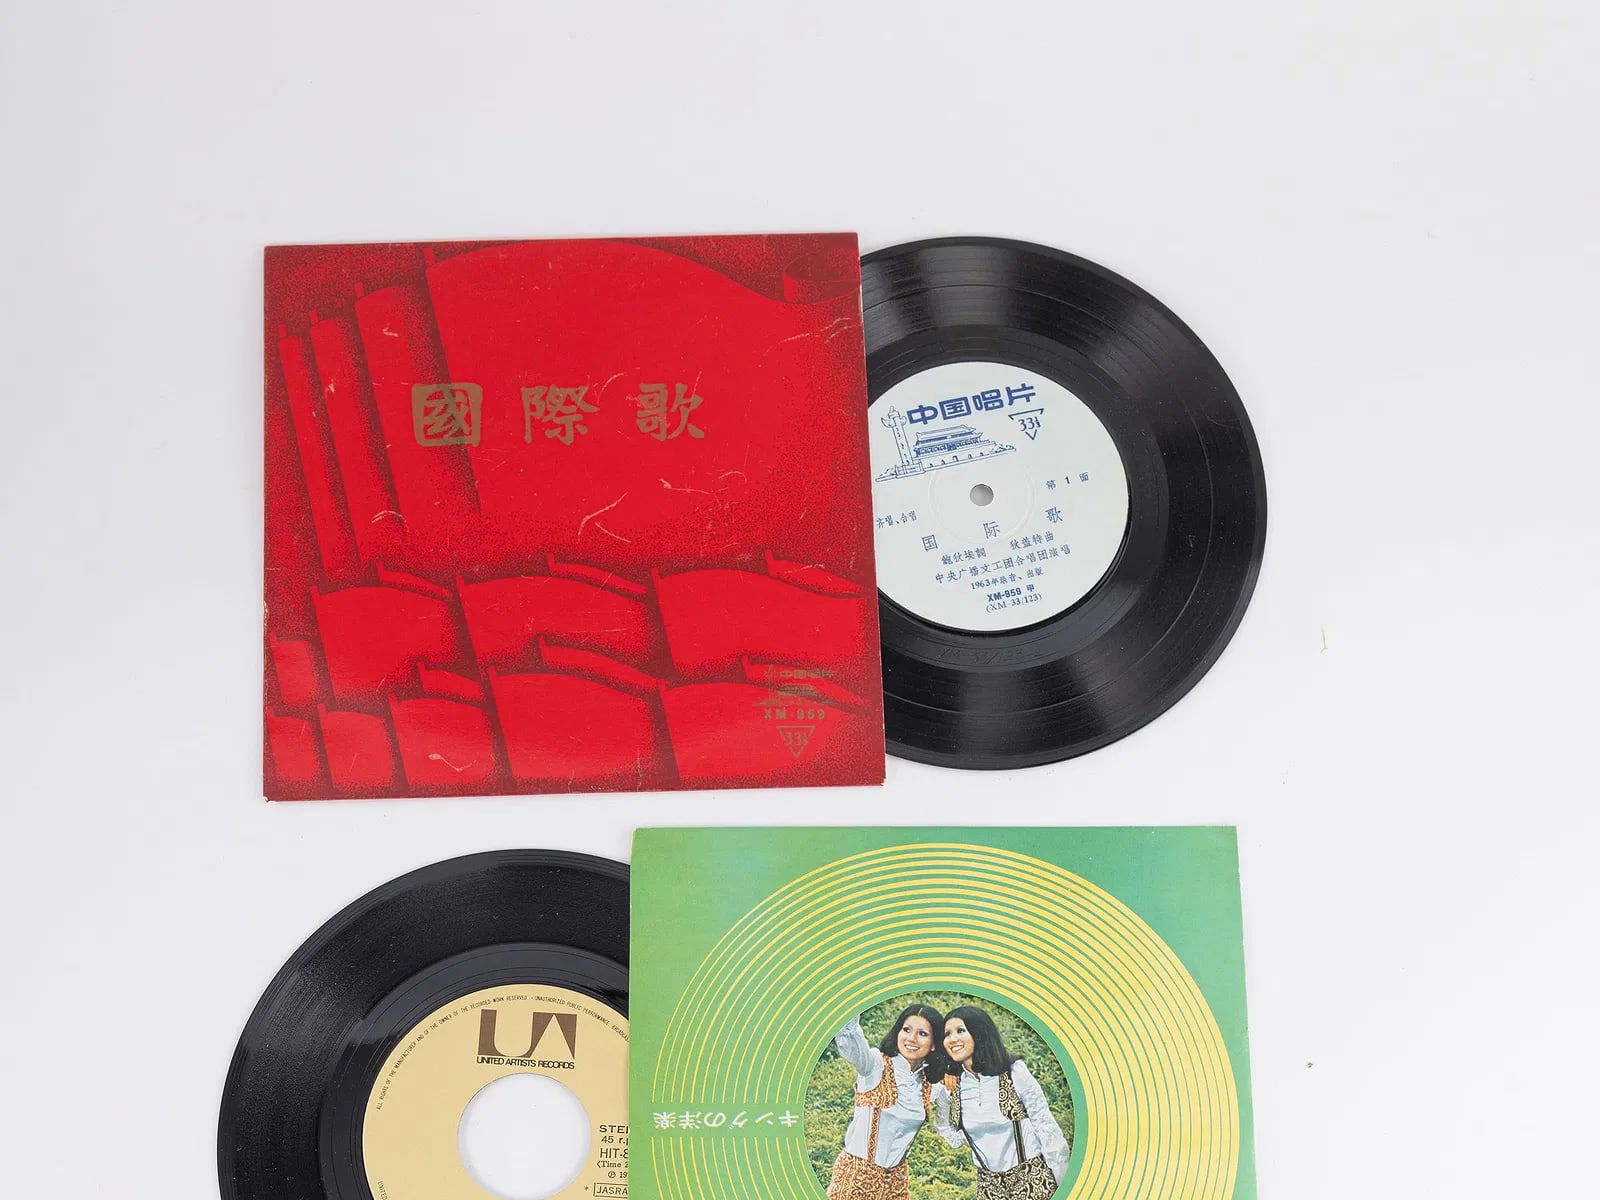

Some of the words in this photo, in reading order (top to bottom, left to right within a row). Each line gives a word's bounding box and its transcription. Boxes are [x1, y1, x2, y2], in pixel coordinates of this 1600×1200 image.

[411, 382, 704, 447] 國際歌
[906, 383, 1037, 425] 中国唱片
[936, 544, 1071, 584] 中央广播文工团合唱团演唱
[476, 1056, 504, 1065] UNITED
[505, 1058, 536, 1067] ARTISTS
[538, 1060, 575, 1069] RECORDS
[653, 1110, 800, 1130] キングの洋楽
[601, 1135, 614, 1144] 45
